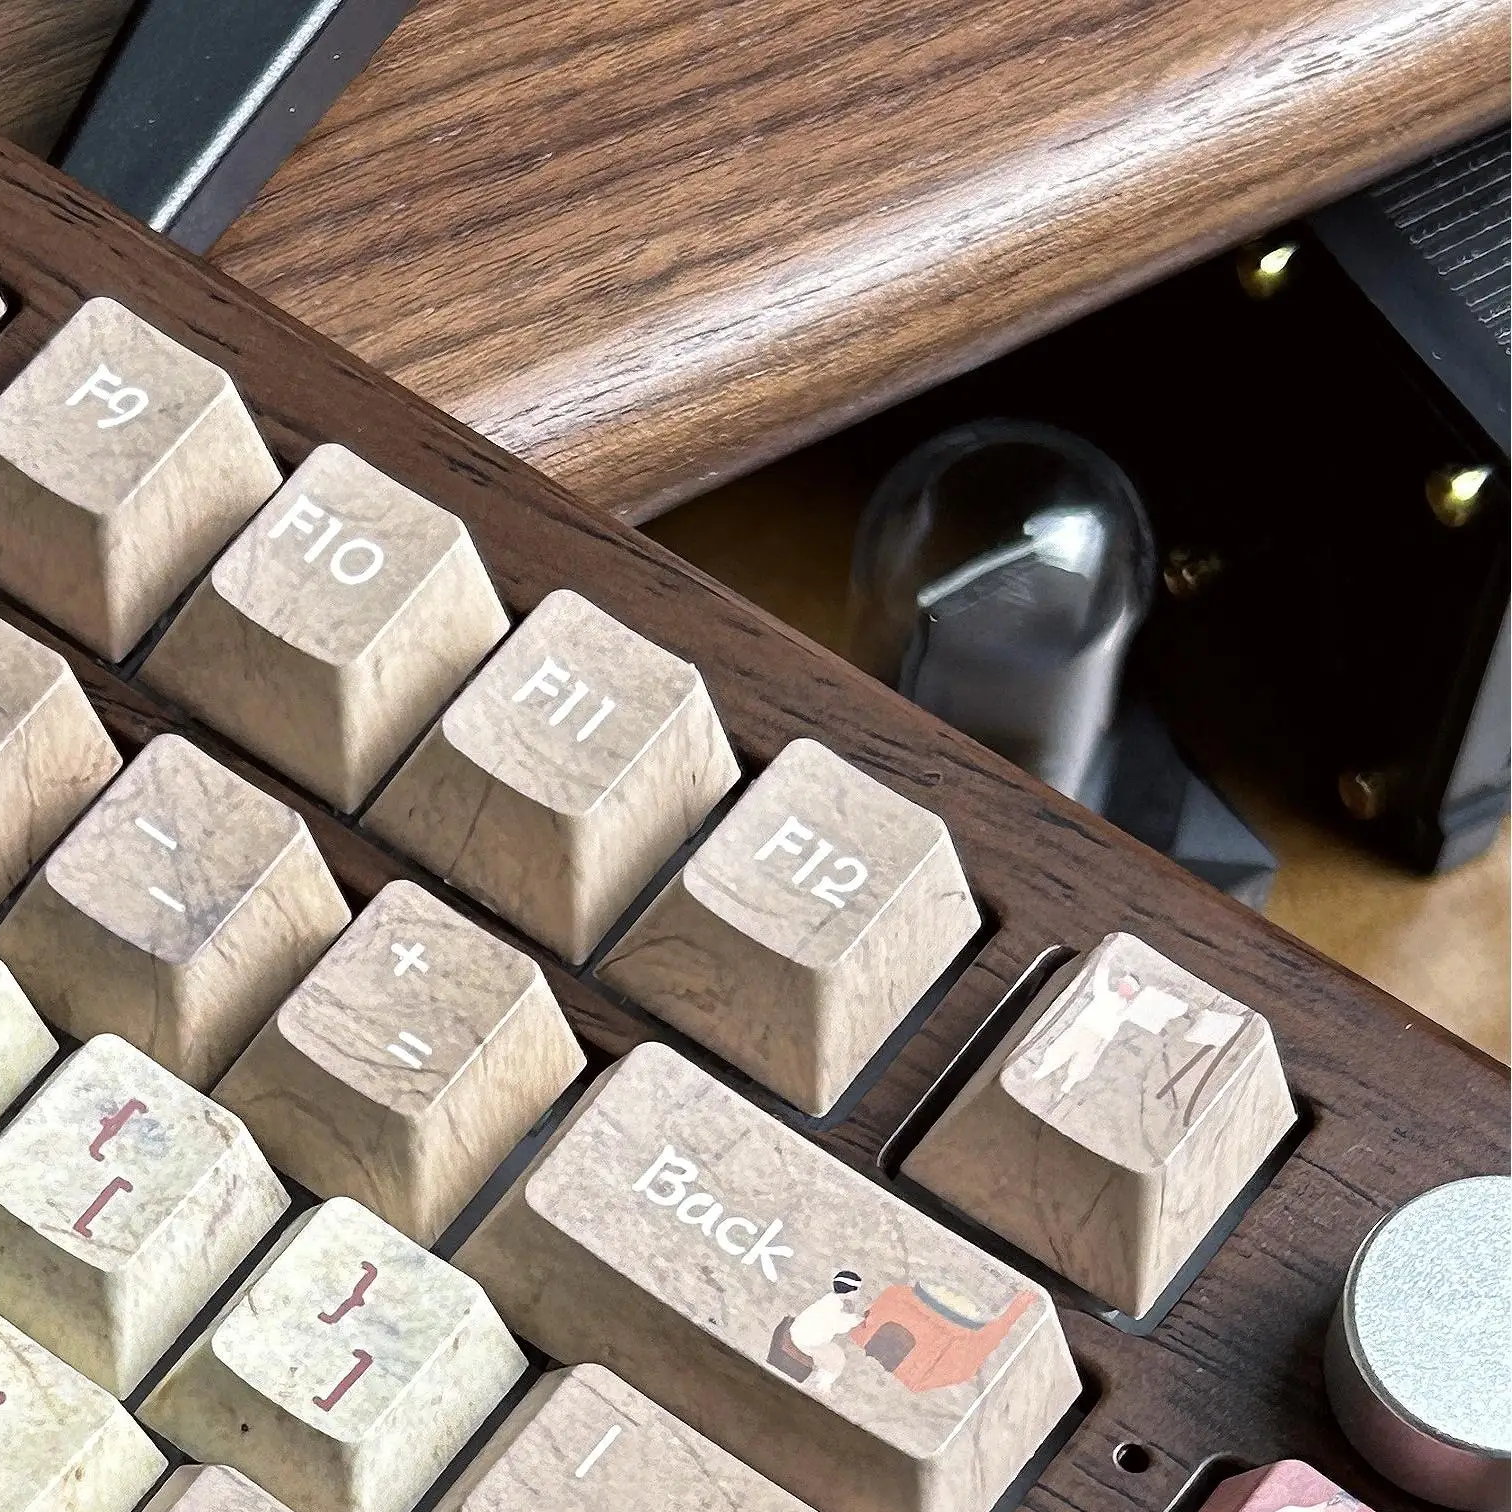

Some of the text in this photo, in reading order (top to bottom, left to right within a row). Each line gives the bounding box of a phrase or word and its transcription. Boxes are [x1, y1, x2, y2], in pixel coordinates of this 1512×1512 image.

[64, 363, 150, 430] F9
[269, 494, 385, 585] F10
[512, 656, 616, 743] F11
[753, 815, 870, 909] F12
[632, 1144, 795, 1283] Back
